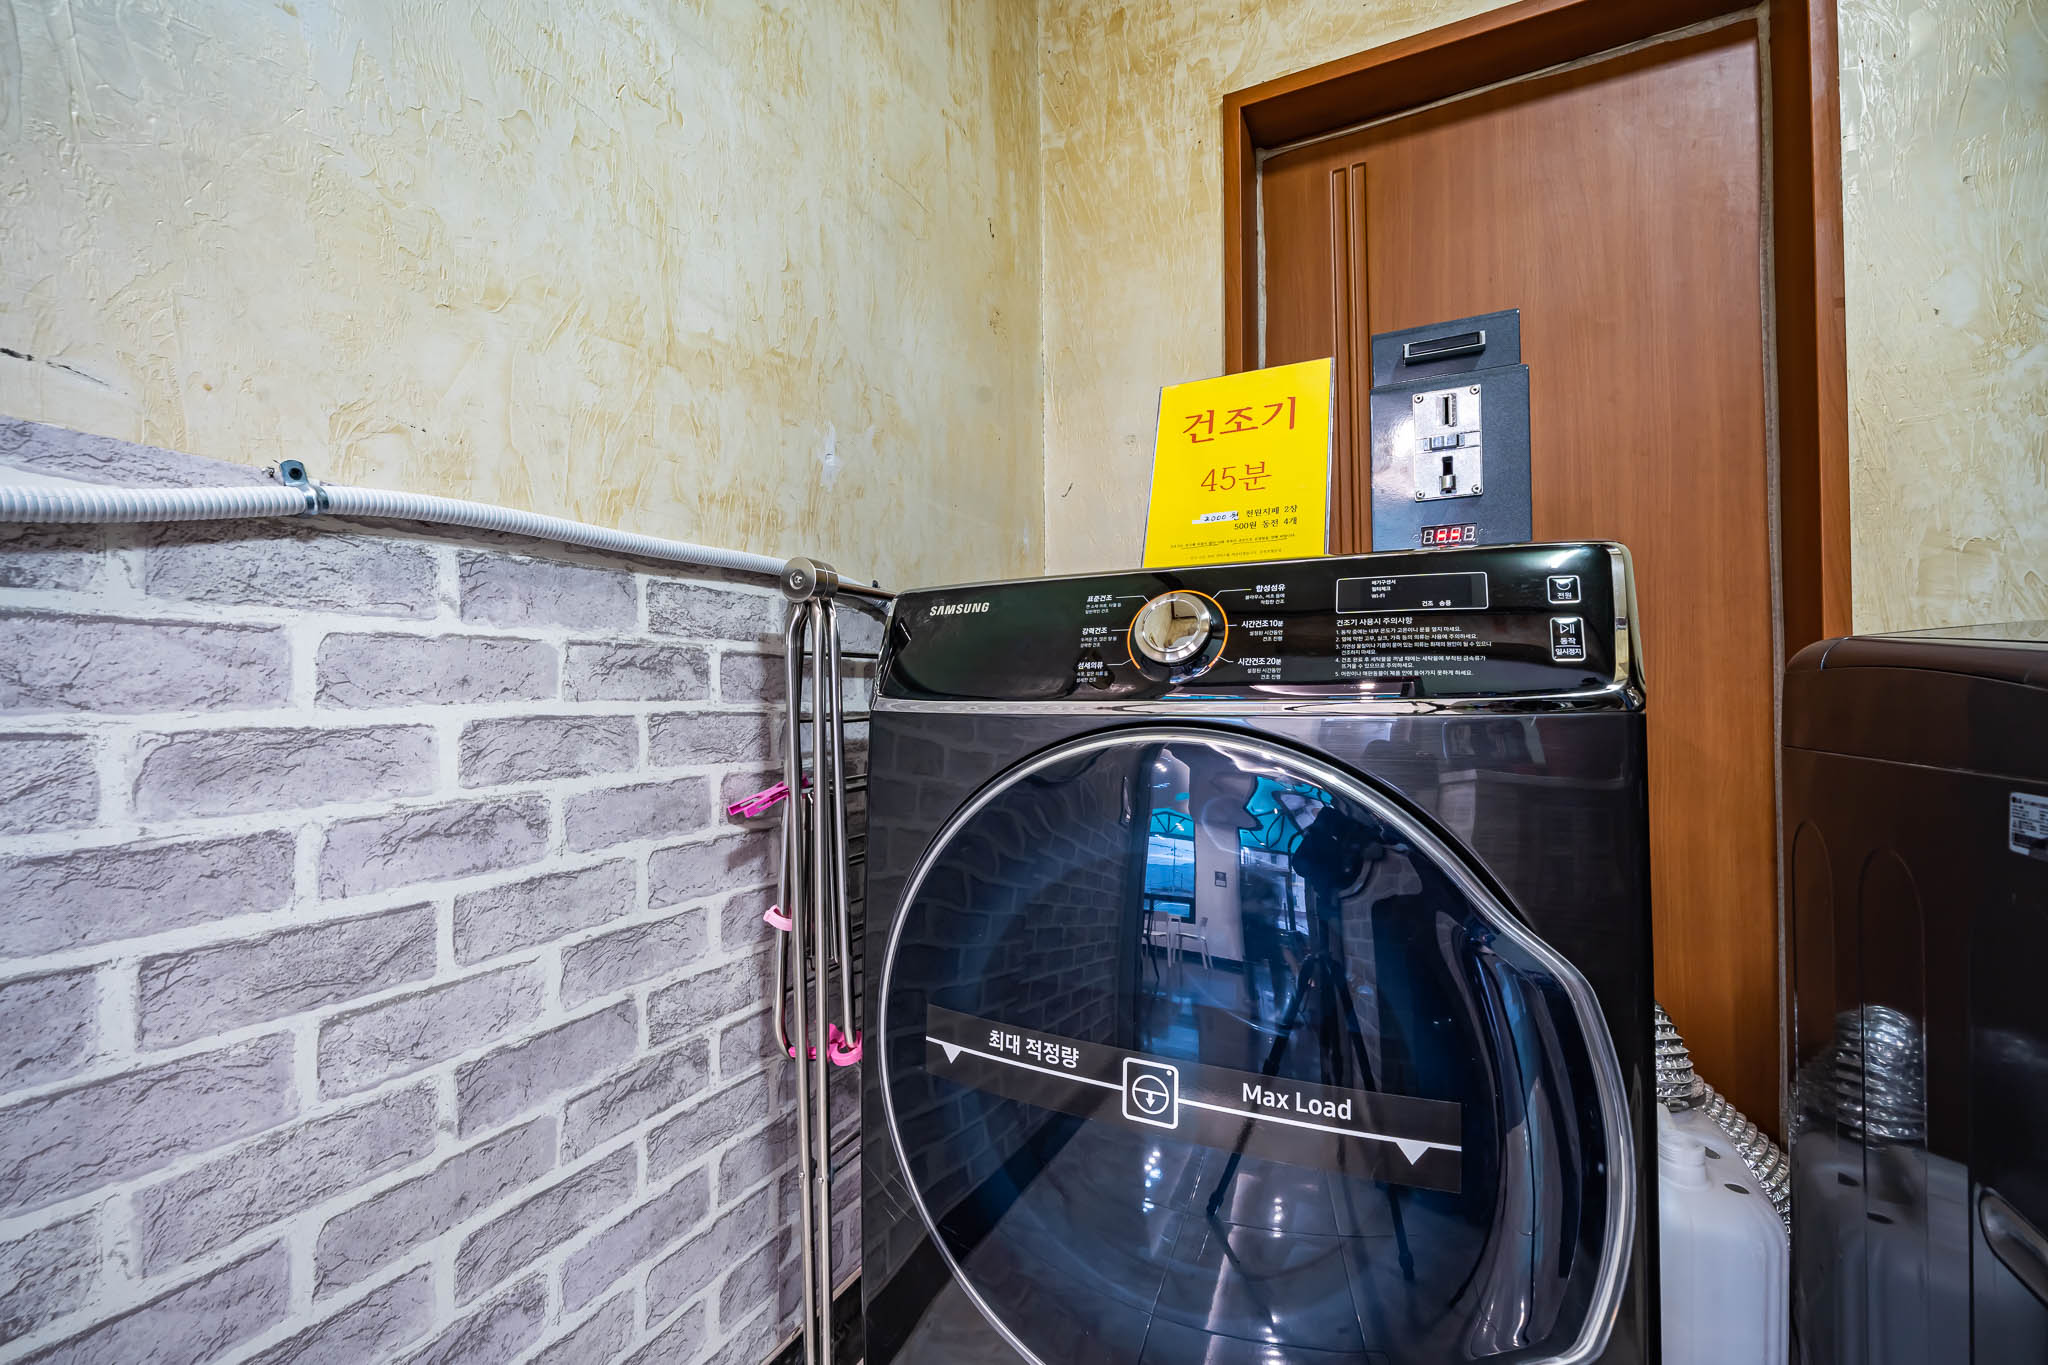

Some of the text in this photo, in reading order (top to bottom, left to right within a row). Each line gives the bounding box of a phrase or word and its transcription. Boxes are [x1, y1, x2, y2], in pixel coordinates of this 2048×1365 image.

[1183, 396, 1296, 443] 건조기
[1201, 461, 1272, 491] 45분
[1246, 507, 1279, 517] 천원지폐
[1234, 521, 1256, 530] 500원
[1262, 519, 1278, 528] 동전
[1256, 584, 1285, 592] 합성섬유
[930, 602, 989, 616] SAMSUNG
[1242, 620, 1268, 628] 시간건조
[1238, 658, 1265, 666] 시간건조
[988, 1030, 1079, 1069] 최대 적정량
[1242, 1083, 1352, 1120] Max Load
